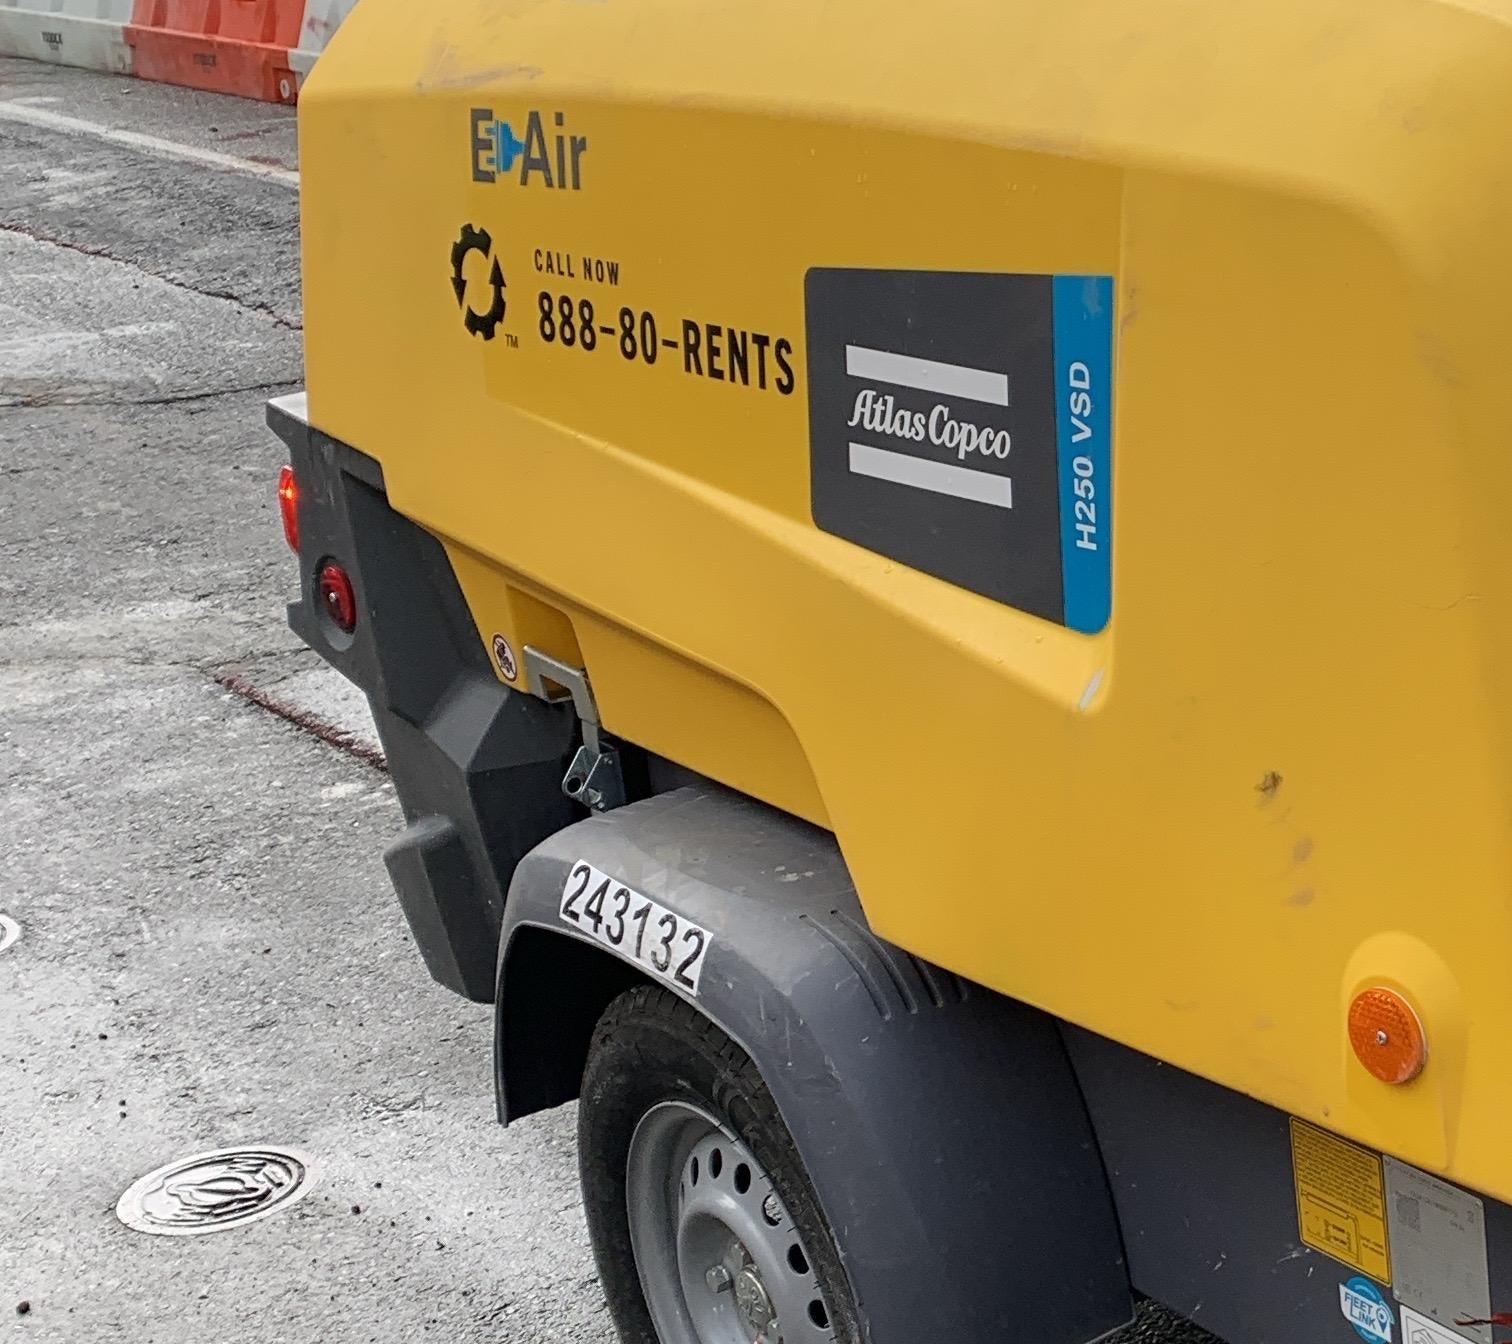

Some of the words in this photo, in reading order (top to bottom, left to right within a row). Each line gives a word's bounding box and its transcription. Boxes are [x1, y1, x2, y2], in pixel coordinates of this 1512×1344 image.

[534, 248, 575, 279] CALL
[582, 256, 620, 286] NOW
[504, 333, 519, 349] TM
[537, 290, 795, 396] 888-80-RENTS
[847, 389, 926, 442] Atlas
[927, 403, 1012, 460] Copco
[1068, 361, 1093, 443] VSD
[1072, 455, 1098, 551] H250
[561, 864, 705, 991] 243132
